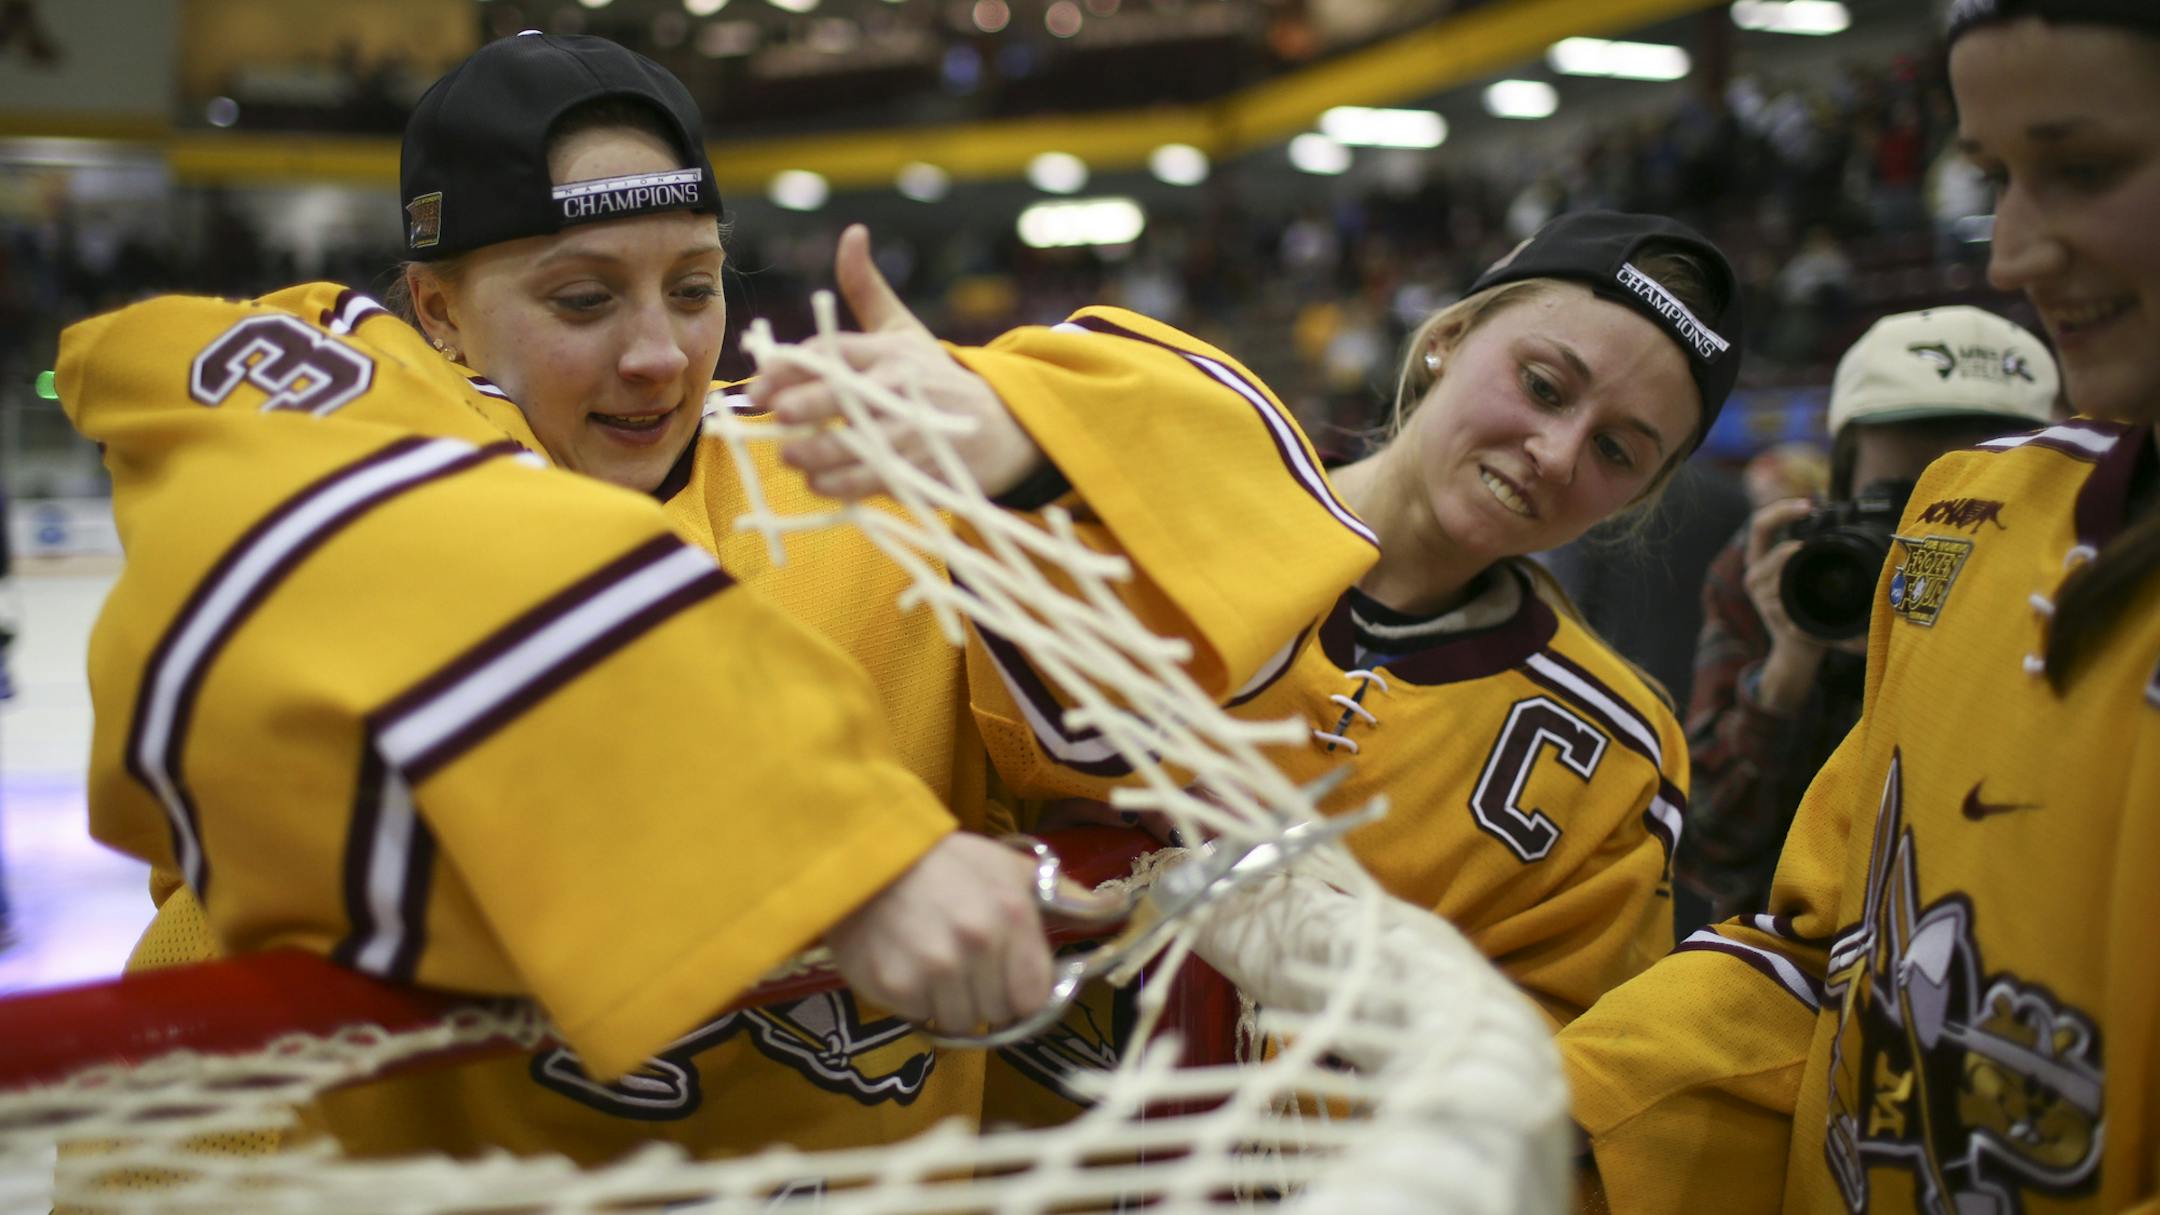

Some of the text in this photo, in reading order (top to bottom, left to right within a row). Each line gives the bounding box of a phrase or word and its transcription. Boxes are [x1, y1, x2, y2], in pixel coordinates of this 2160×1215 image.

[563, 183, 699, 218] CHAMPIONS
[564, 174, 699, 196] NATIONAL
[1615, 268, 1717, 359] CHAMPIONS
[190, 313, 375, 416] 3
[1469, 696, 1611, 864] C
